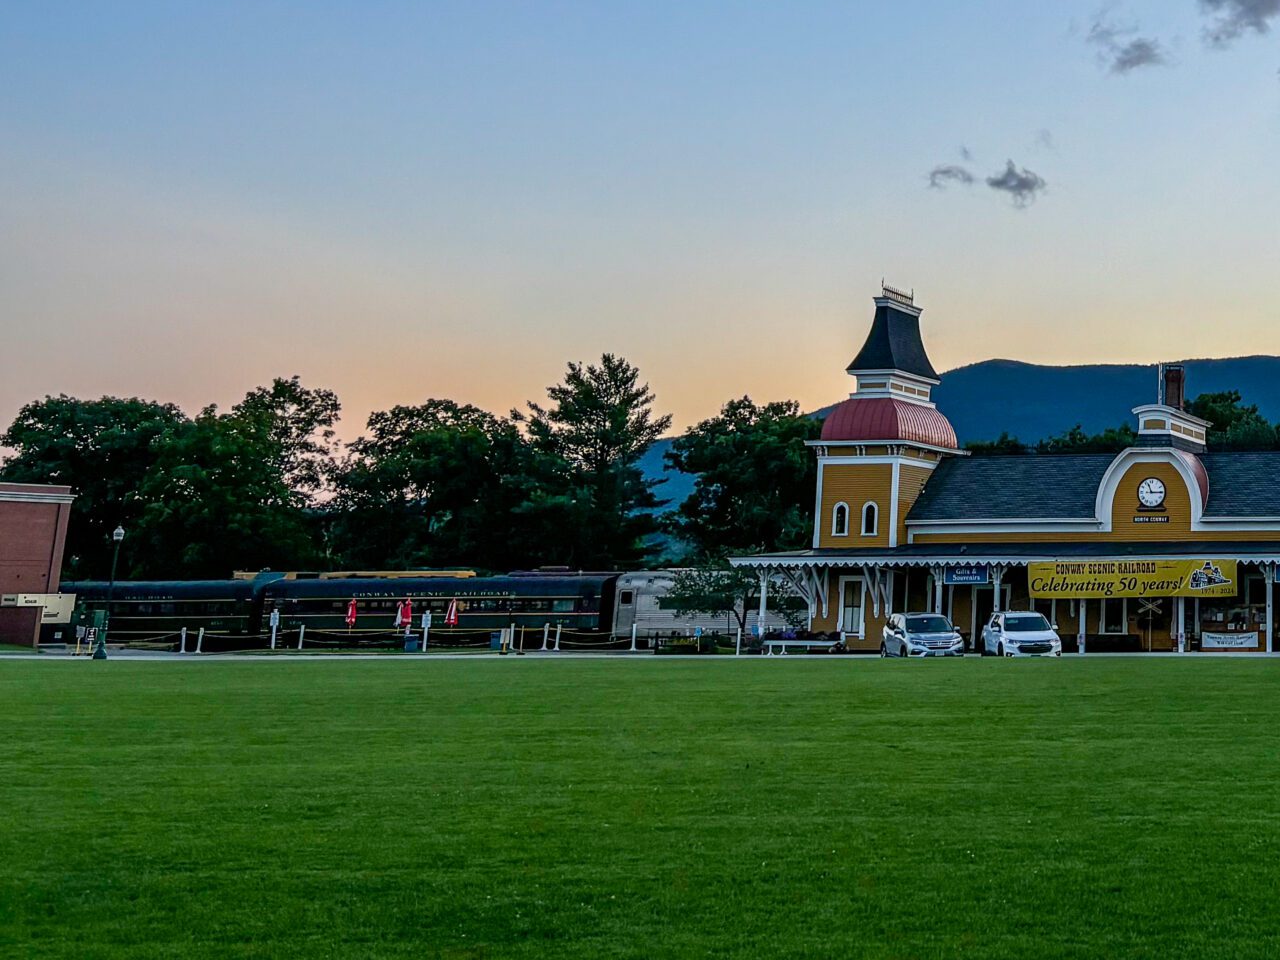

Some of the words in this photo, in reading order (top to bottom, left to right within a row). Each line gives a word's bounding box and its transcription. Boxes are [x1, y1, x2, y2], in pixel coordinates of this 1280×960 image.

[1055, 564, 1086, 574] CONWAY
[1088, 563, 1115, 574] SCENIC
[1118, 562, 1156, 574] RAILROAD
[1031, 577, 1114, 596] Celebrating
[1117, 577, 1137, 592] 50
[1139, 576, 1183, 595] years!
